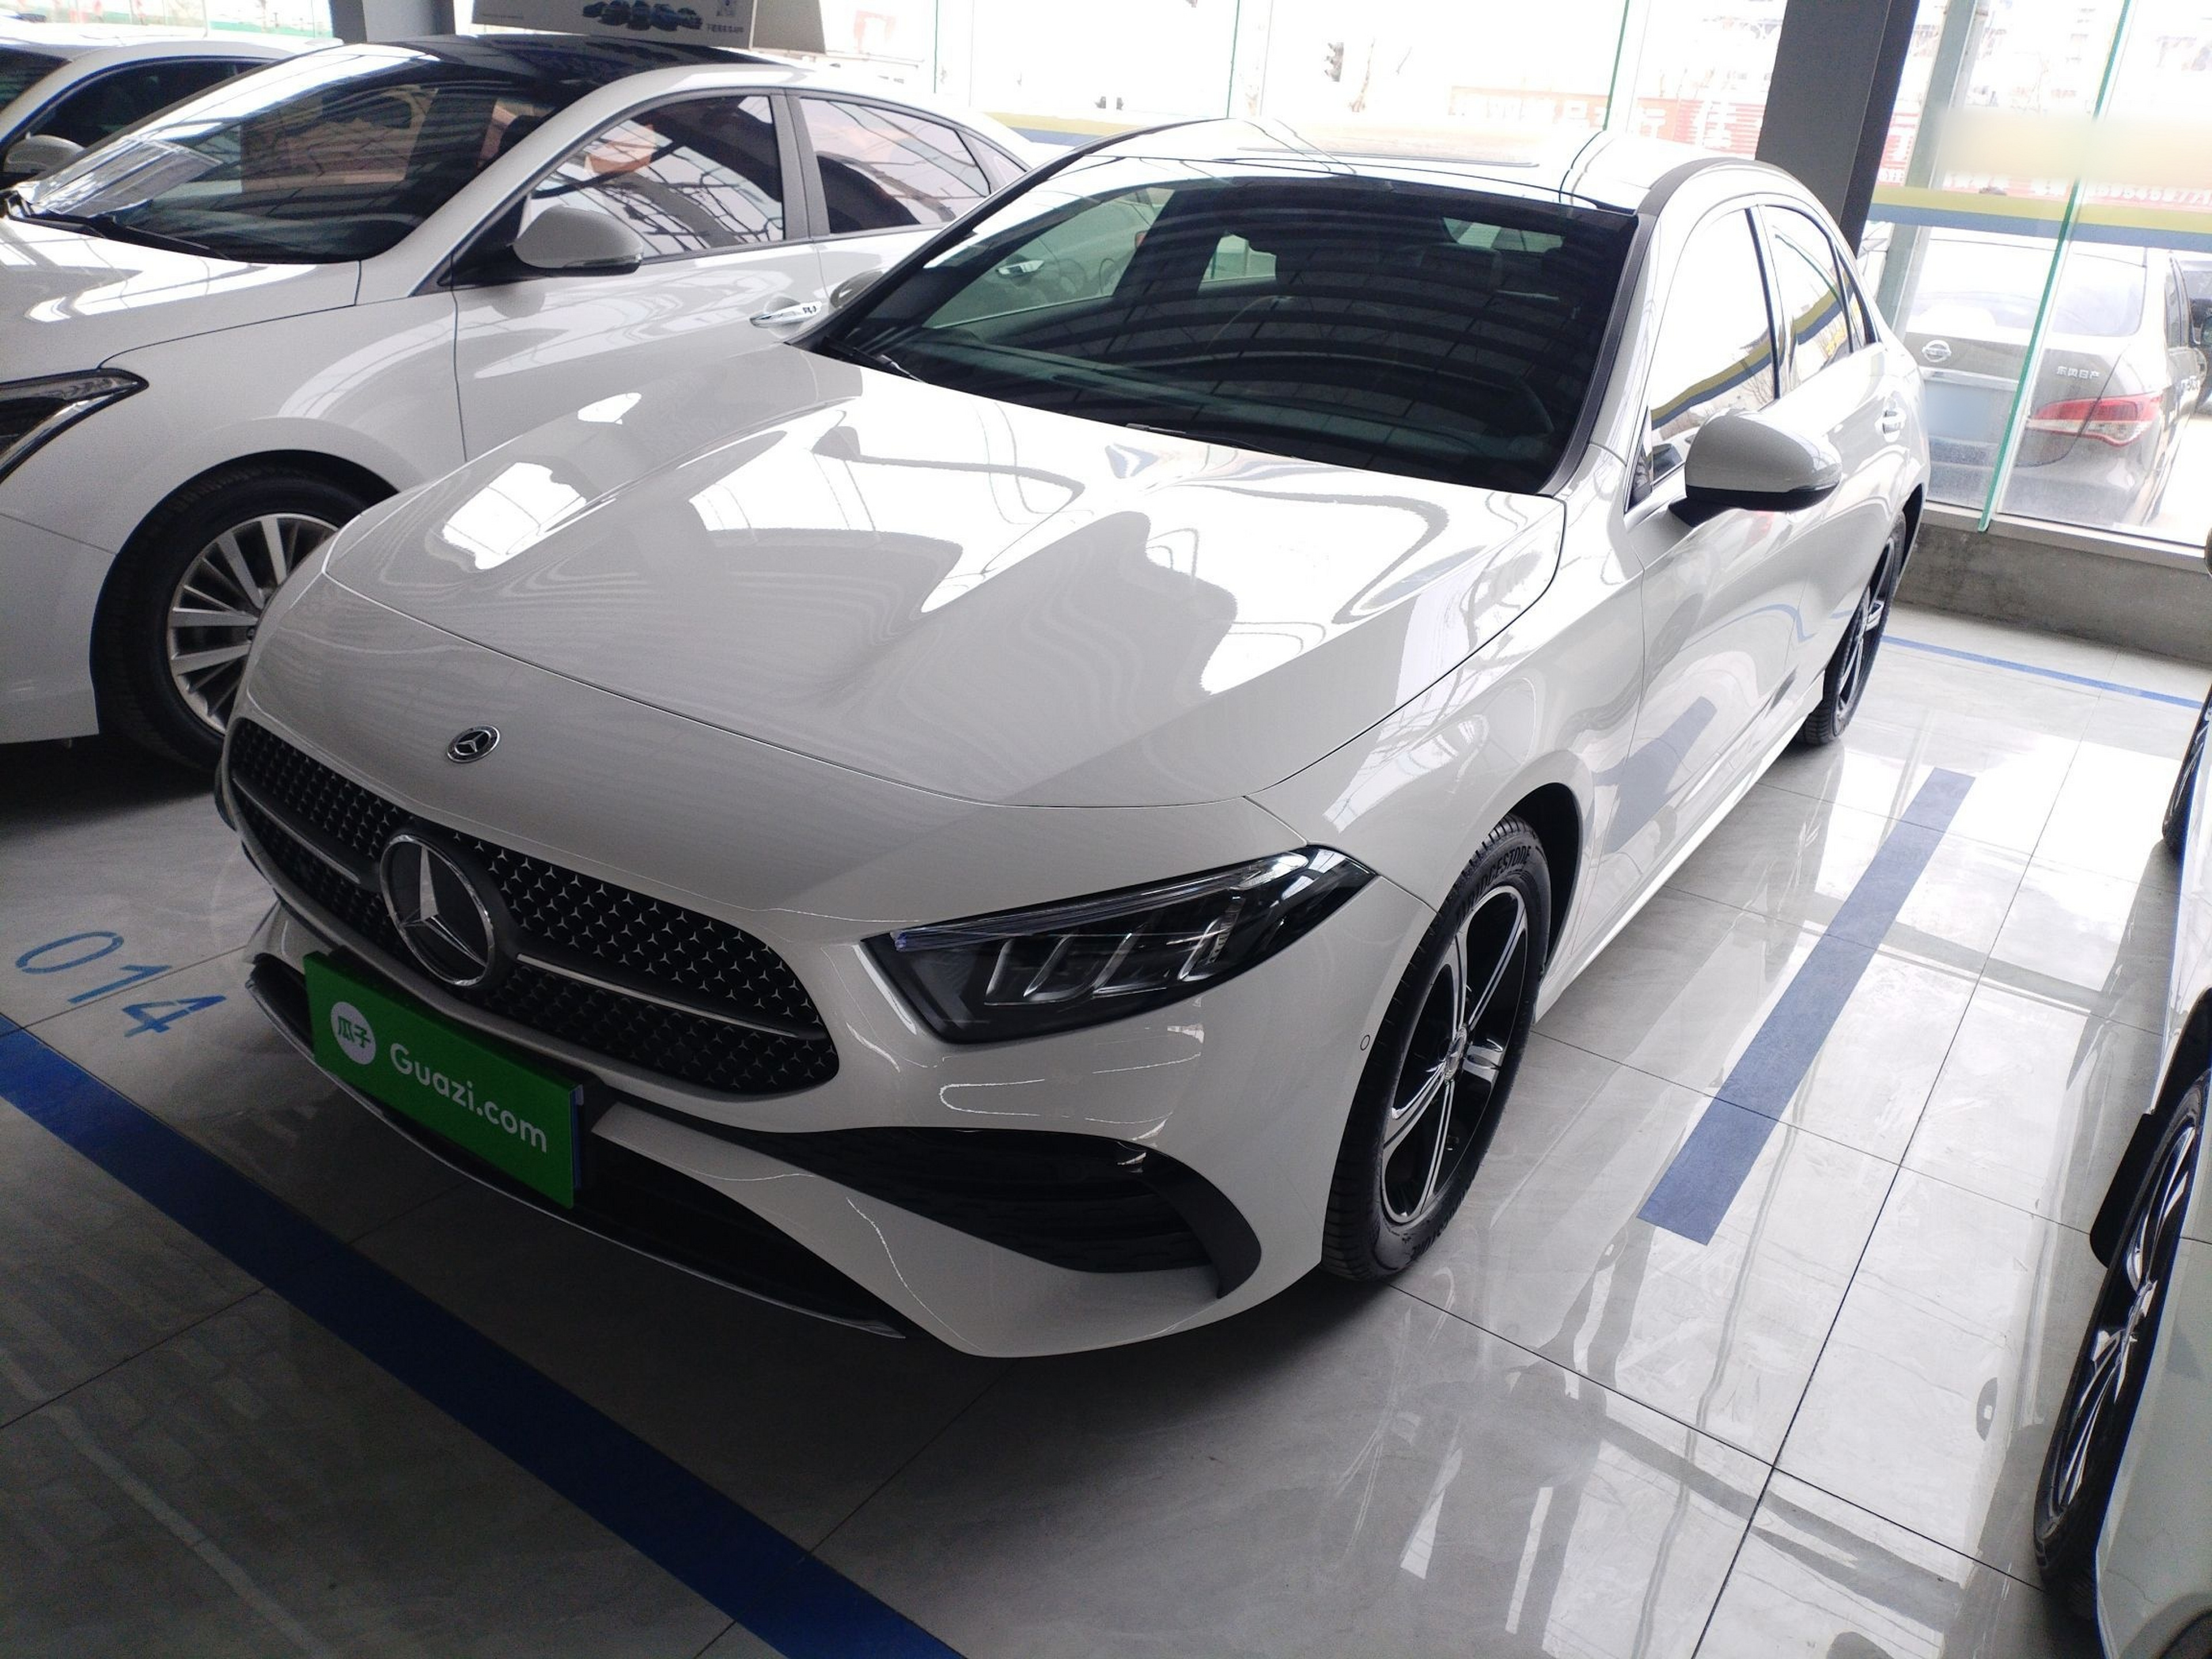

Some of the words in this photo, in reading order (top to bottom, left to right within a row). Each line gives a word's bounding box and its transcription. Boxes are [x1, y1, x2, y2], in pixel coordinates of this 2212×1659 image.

[2057, 366, 2100, 380] 东风日产
[16, 931, 227, 1038] 014
[337, 1016, 371, 1048] 瓜子
[390, 1042, 547, 1153] Guazi.com
